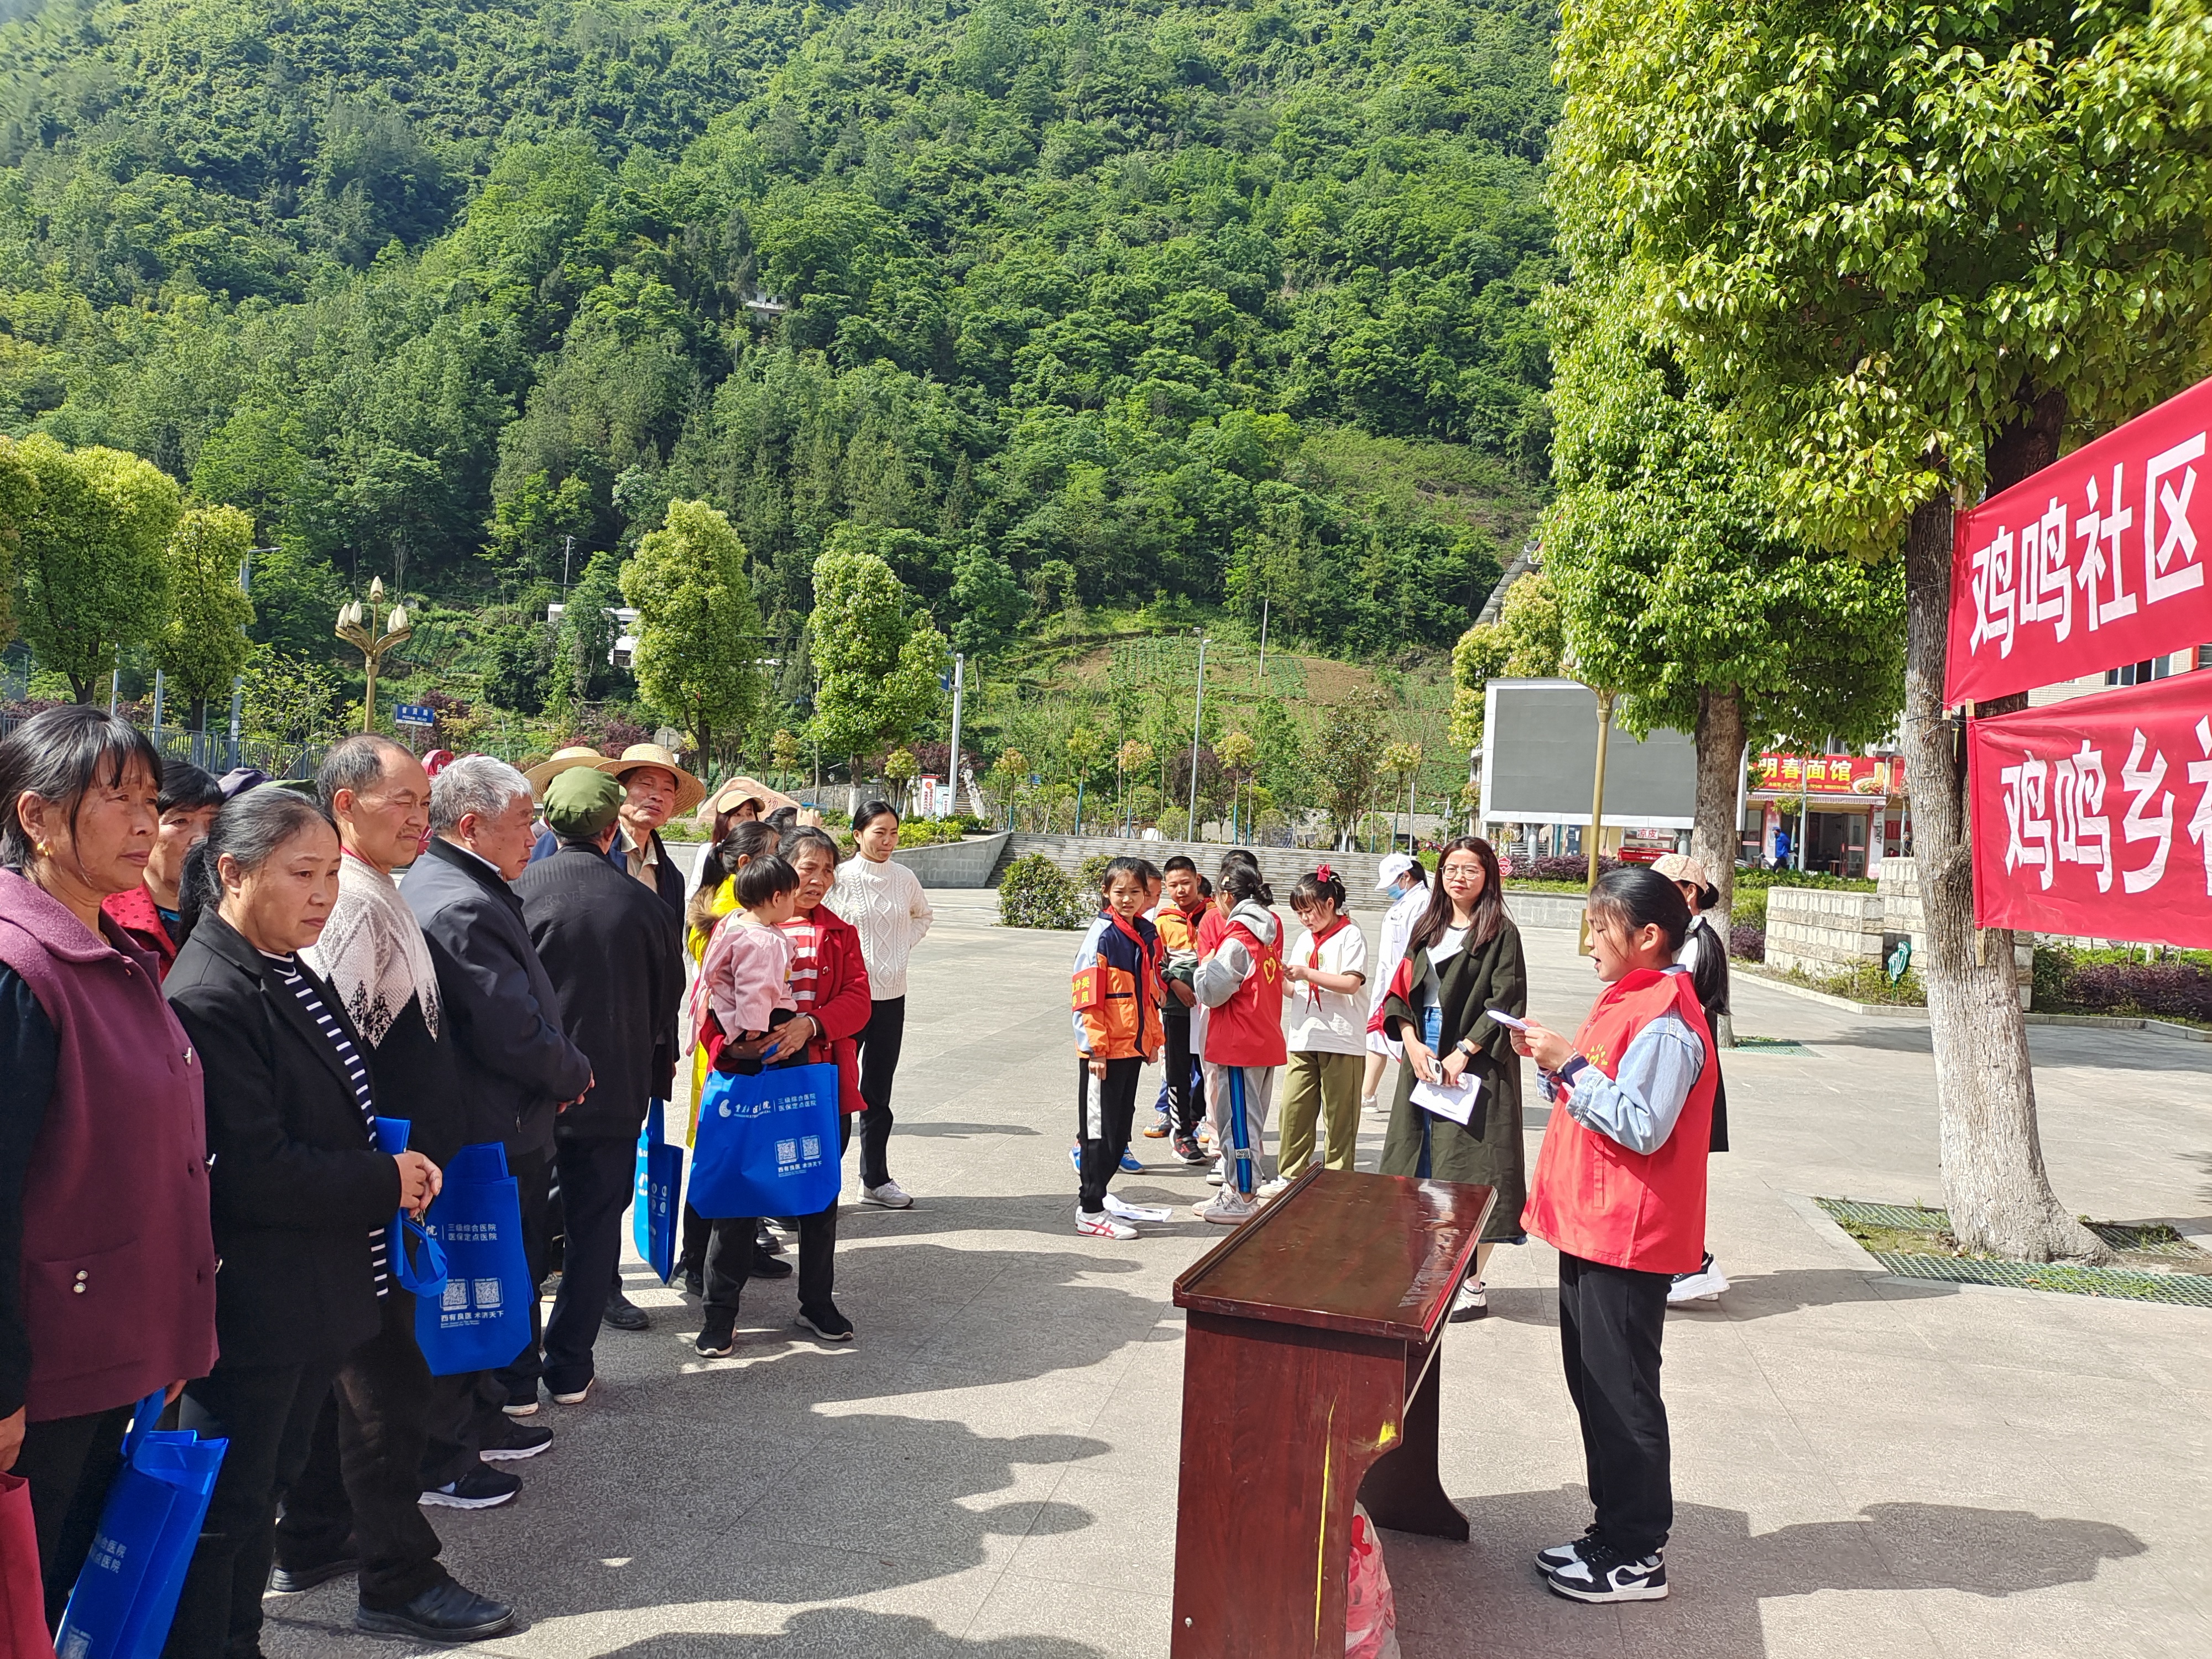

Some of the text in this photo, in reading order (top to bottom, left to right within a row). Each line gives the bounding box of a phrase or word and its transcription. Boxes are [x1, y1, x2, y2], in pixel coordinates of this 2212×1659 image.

[1970, 431, 2206, 659] 鸡鸣社区
[447, 1223, 497, 1232] 三级综合医院
[448, 1233, 498, 1241] 医保定点医院
